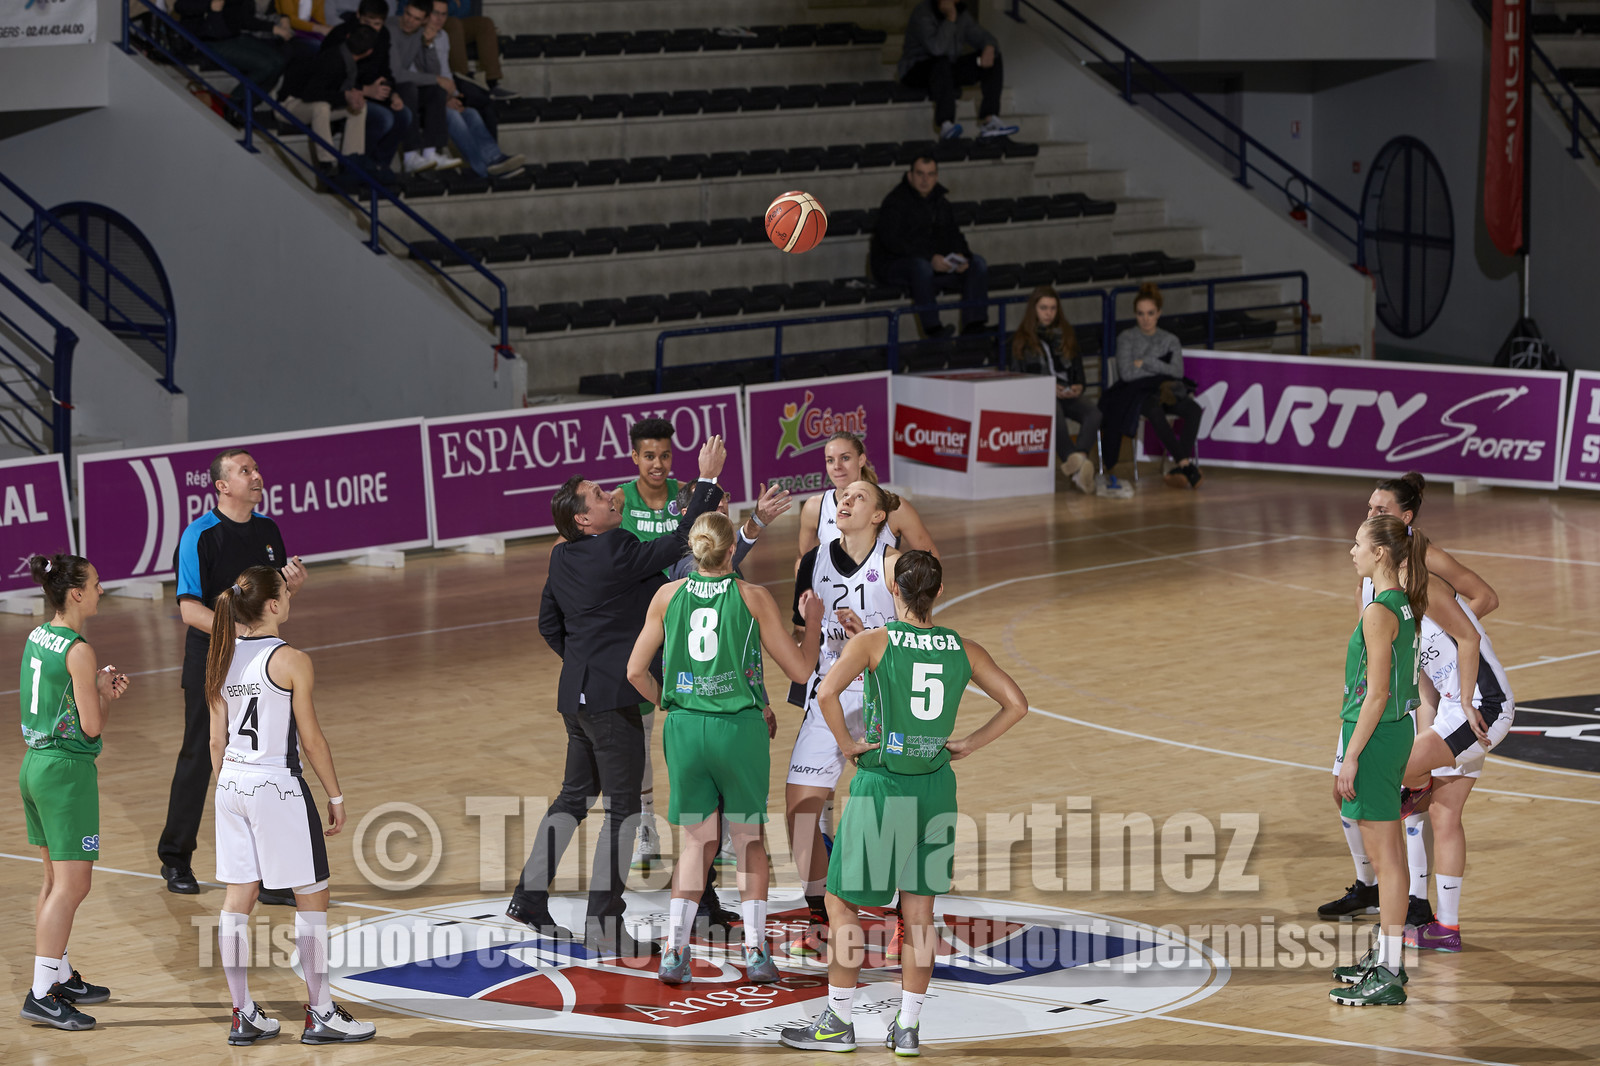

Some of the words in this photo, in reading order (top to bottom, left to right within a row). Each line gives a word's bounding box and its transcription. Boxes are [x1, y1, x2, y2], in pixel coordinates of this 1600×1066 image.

[1504, 0, 1520, 164] ANGE
[804, 405, 867, 438] Géant
[904, 423, 967, 447] Courrier
[989, 424, 1049, 451] Courrier
[439, 419, 585, 478] ESPACE
[596, 403, 728, 461] ANOU
[186, 470, 212, 488] Régi
[290, 481, 319, 513] LA
[325, 472, 388, 508] LOIRE
[768, 472, 823, 492] ESPACE
[0, 483, 48, 527] AL
[637, 520, 654, 533] UNI
[833, 584, 865, 610] 21
[688, 608, 718, 661] 8
[888, 630, 960, 651] VARGA
[30, 656, 42, 715] 1
[227, 683, 261, 697] BERNIES
[910, 662, 944, 720] 5
[238, 697, 258, 751] 4
